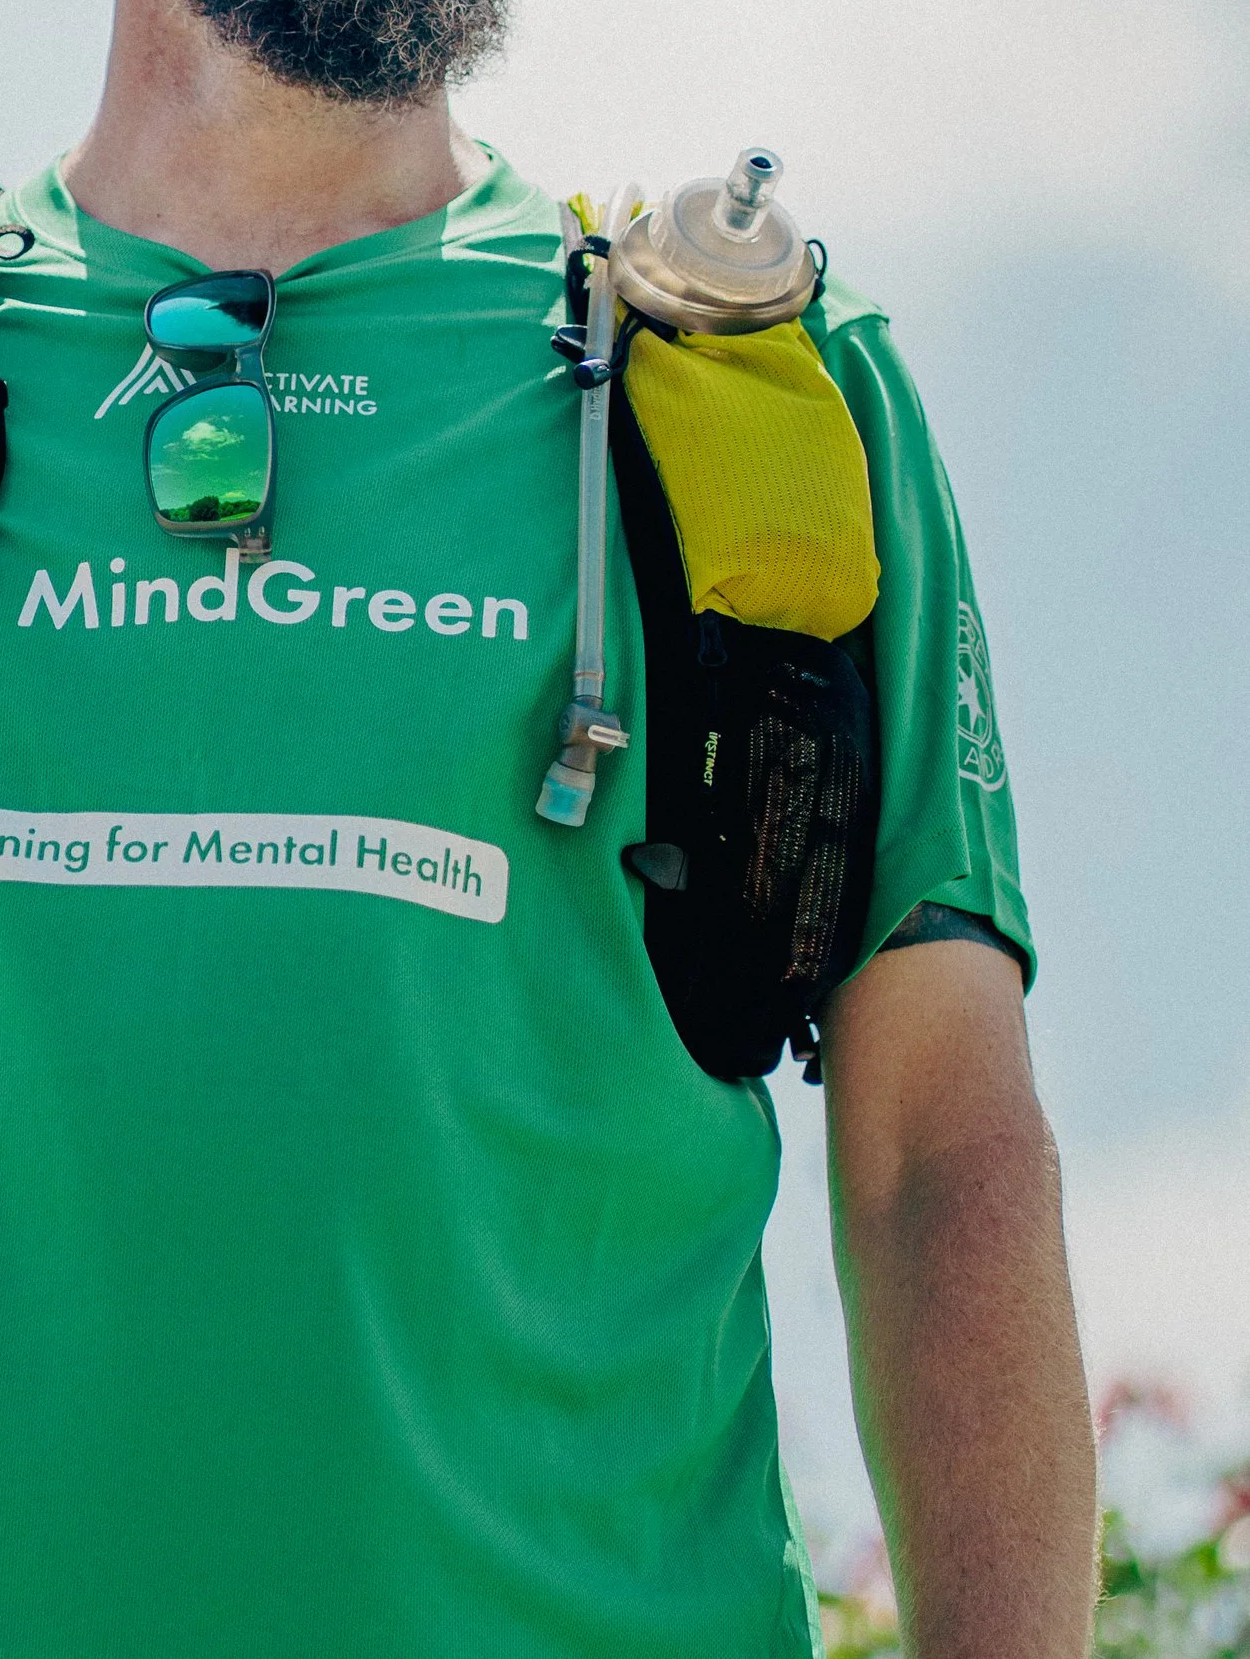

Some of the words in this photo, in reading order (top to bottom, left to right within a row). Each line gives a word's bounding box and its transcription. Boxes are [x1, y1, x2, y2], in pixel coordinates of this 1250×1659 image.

[16, 546, 529, 640] MindGreen
[105, 824, 169, 866] for
[181, 828, 338, 868] Mental
[355, 834, 484, 898] Health
